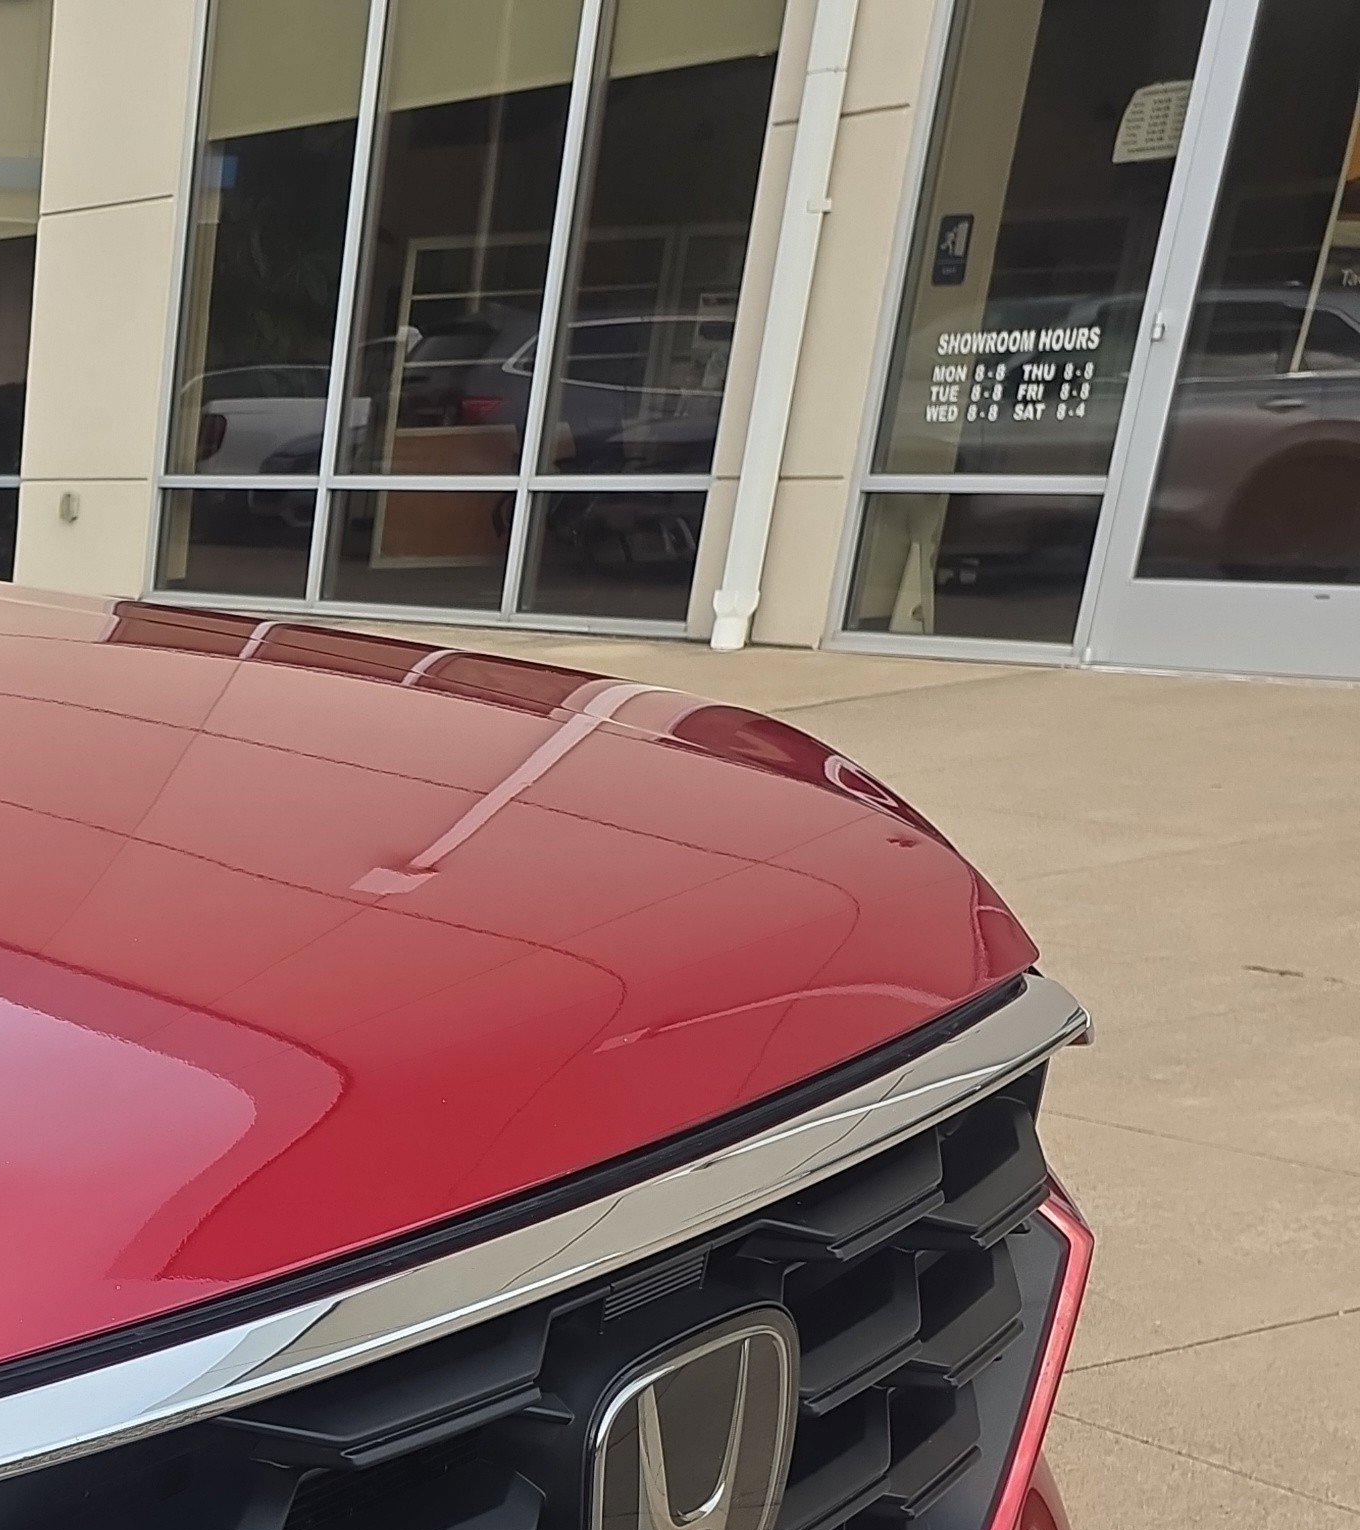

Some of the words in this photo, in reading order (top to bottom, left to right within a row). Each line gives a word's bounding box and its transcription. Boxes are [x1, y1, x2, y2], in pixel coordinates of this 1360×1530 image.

[937, 329, 1037, 356] SHOWROOM
[1038, 325, 1101, 351] HOURS
[932, 363, 968, 383] MON
[1022, 361, 1056, 381] THU
[930, 384, 960, 403] TUE
[1016, 382, 1045, 401] FRI
[925, 404, 959, 422] WED
[1013, 402, 1046, 421] SAT
